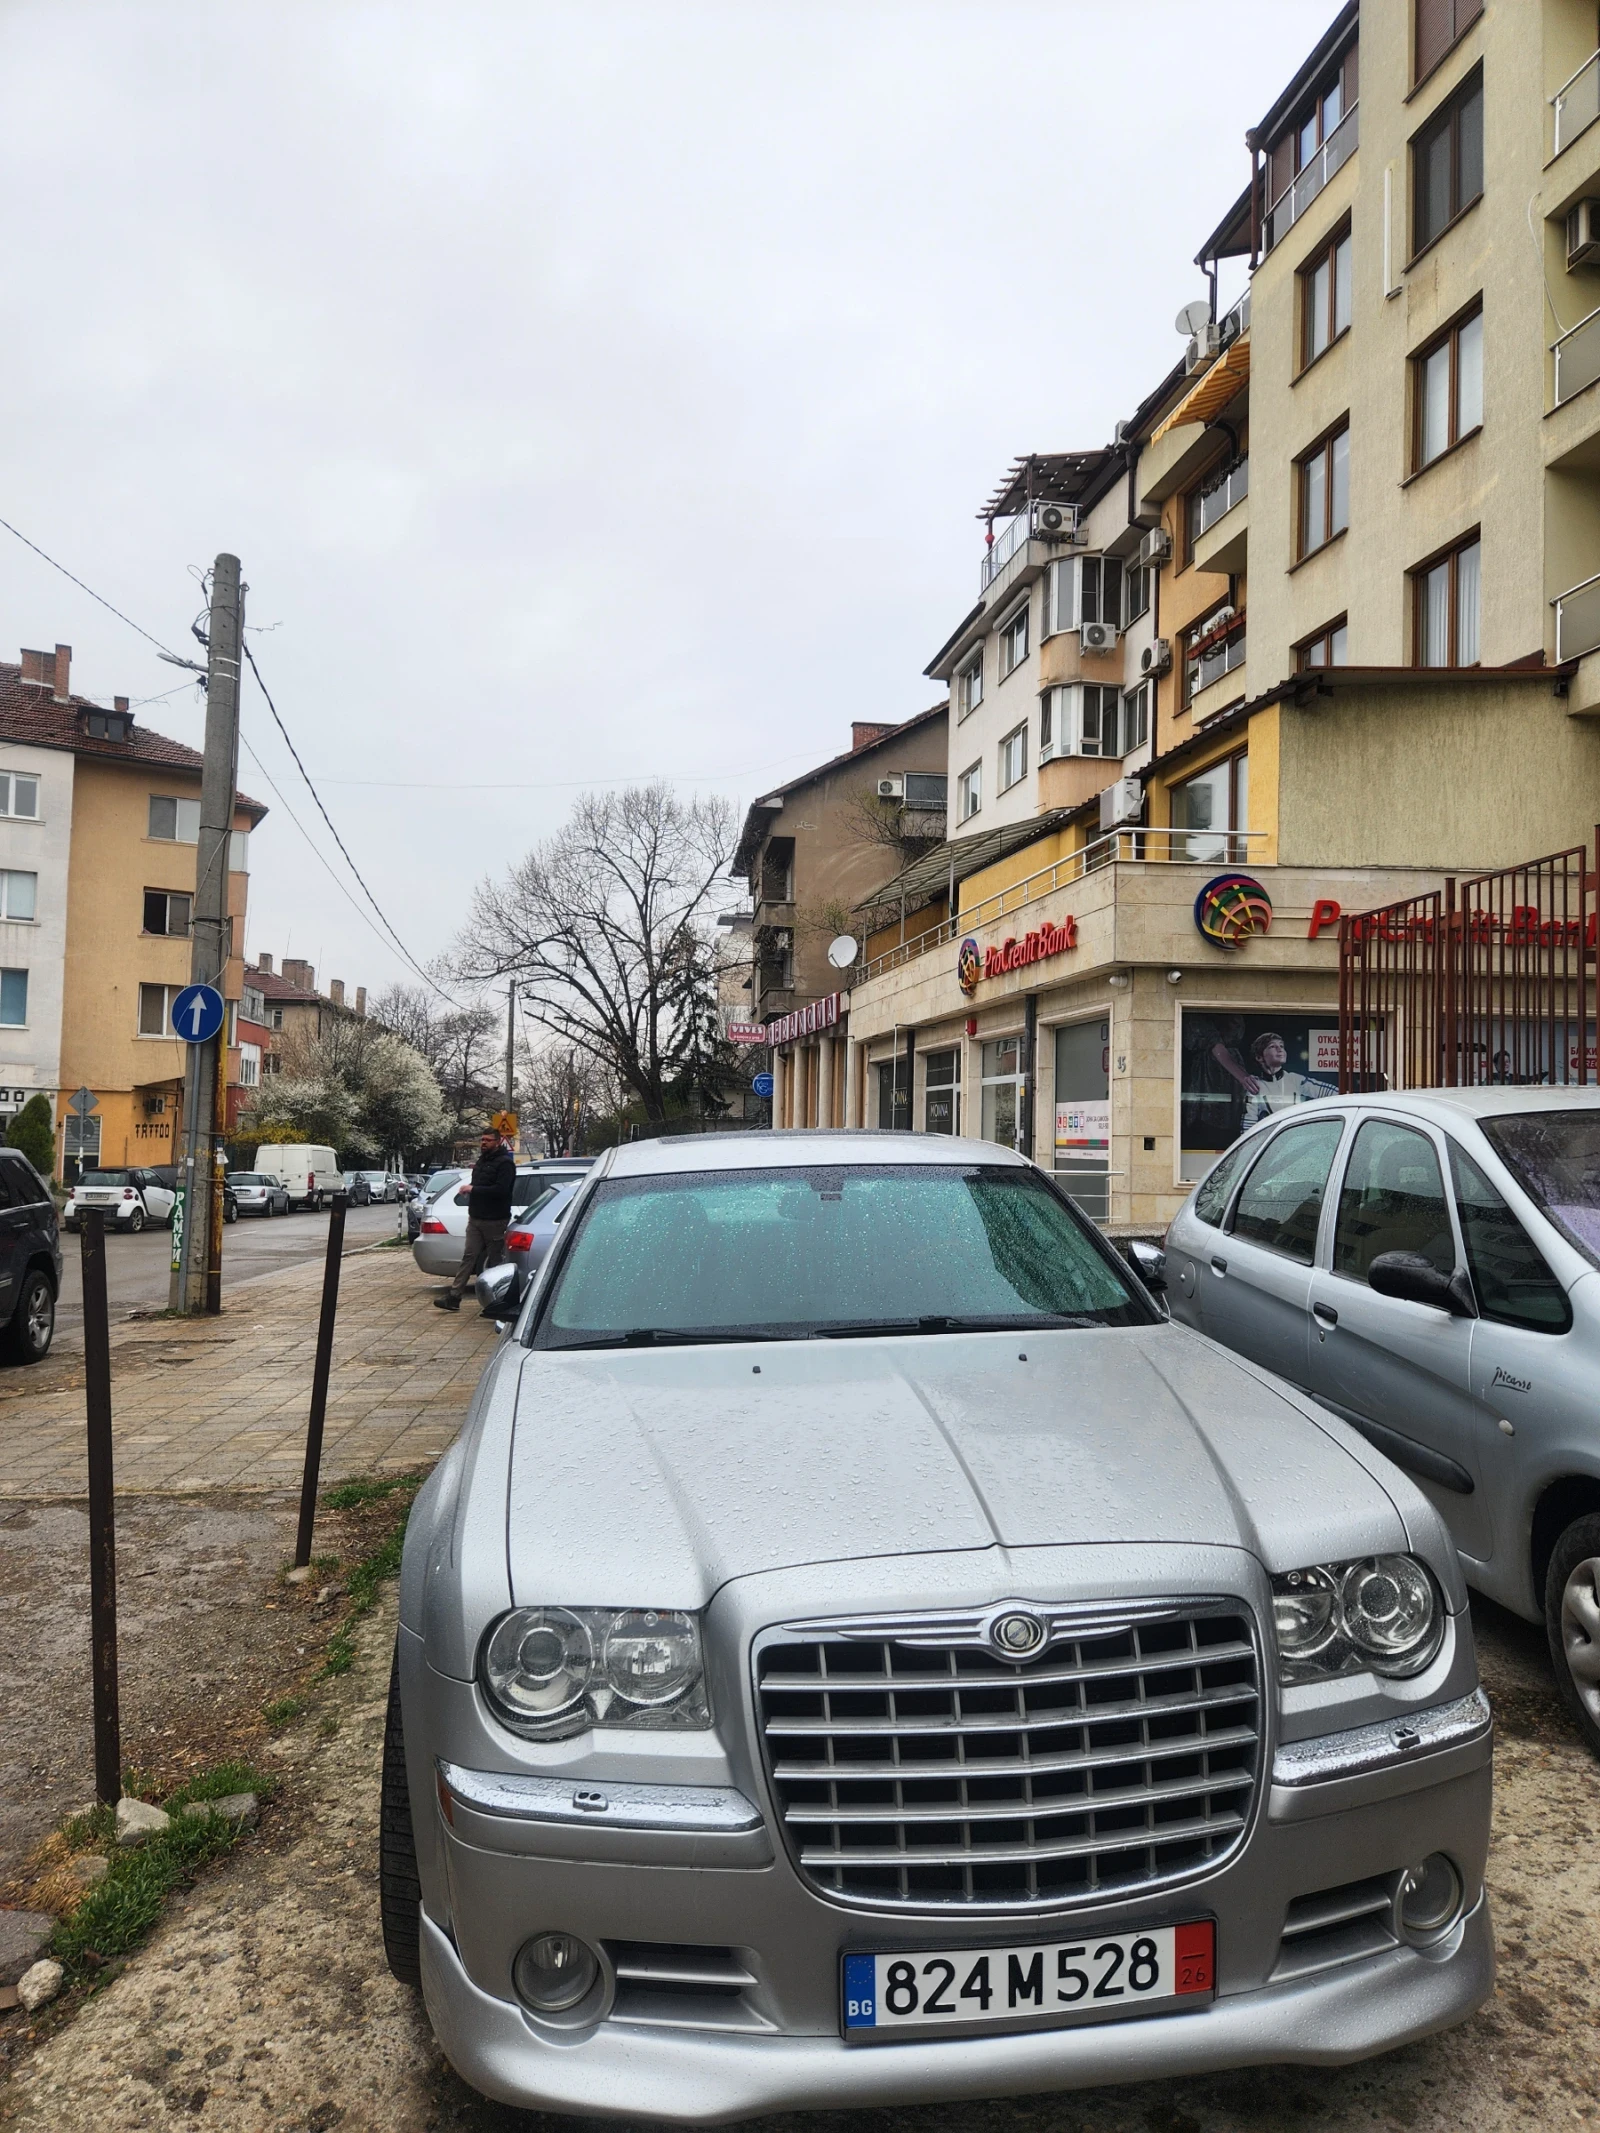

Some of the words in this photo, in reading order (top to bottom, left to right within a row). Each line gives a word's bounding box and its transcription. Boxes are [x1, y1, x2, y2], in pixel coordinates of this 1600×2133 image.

[984, 931, 1040, 978] ProCredit
[1037, 914, 1078, 959] Bank
[731, 1025, 763, 1035] VIVES
[1317, 1048, 1328, 1057] ДА
[930, 1103, 949, 1117] MONNA
[135, 1122, 170, 1139] TATTOO
[172, 1191, 185, 1263] РАМКИ
[848, 1999, 873, 2016] BG
[1182, 1966, 1206, 1985] 26
